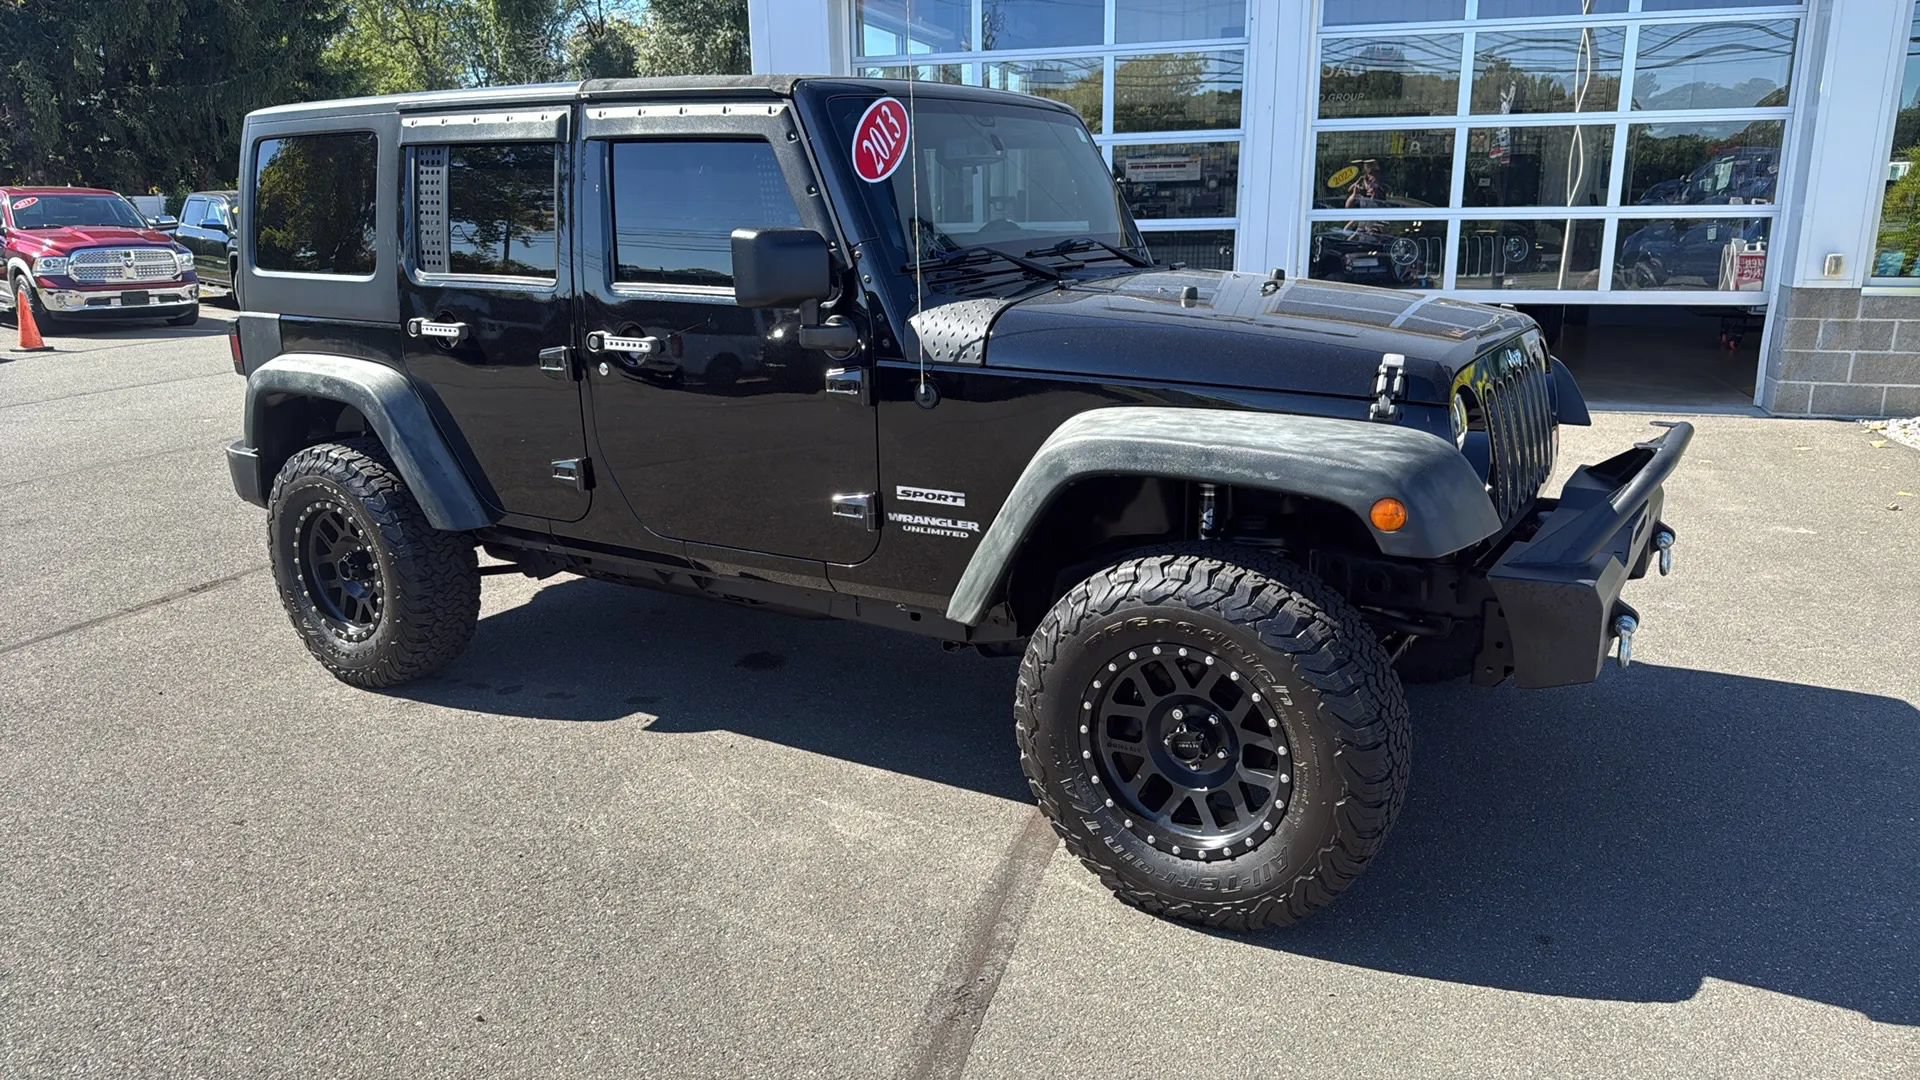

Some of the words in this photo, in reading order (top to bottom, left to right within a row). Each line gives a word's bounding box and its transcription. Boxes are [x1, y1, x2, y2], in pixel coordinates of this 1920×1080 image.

[1328, 92, 1365, 102] GROUP
[862, 105, 901, 175] 2013
[897, 488, 965, 504] SPORT
[888, 512, 980, 532] WRANGLER
[902, 525, 969, 538] UNLIMITED
